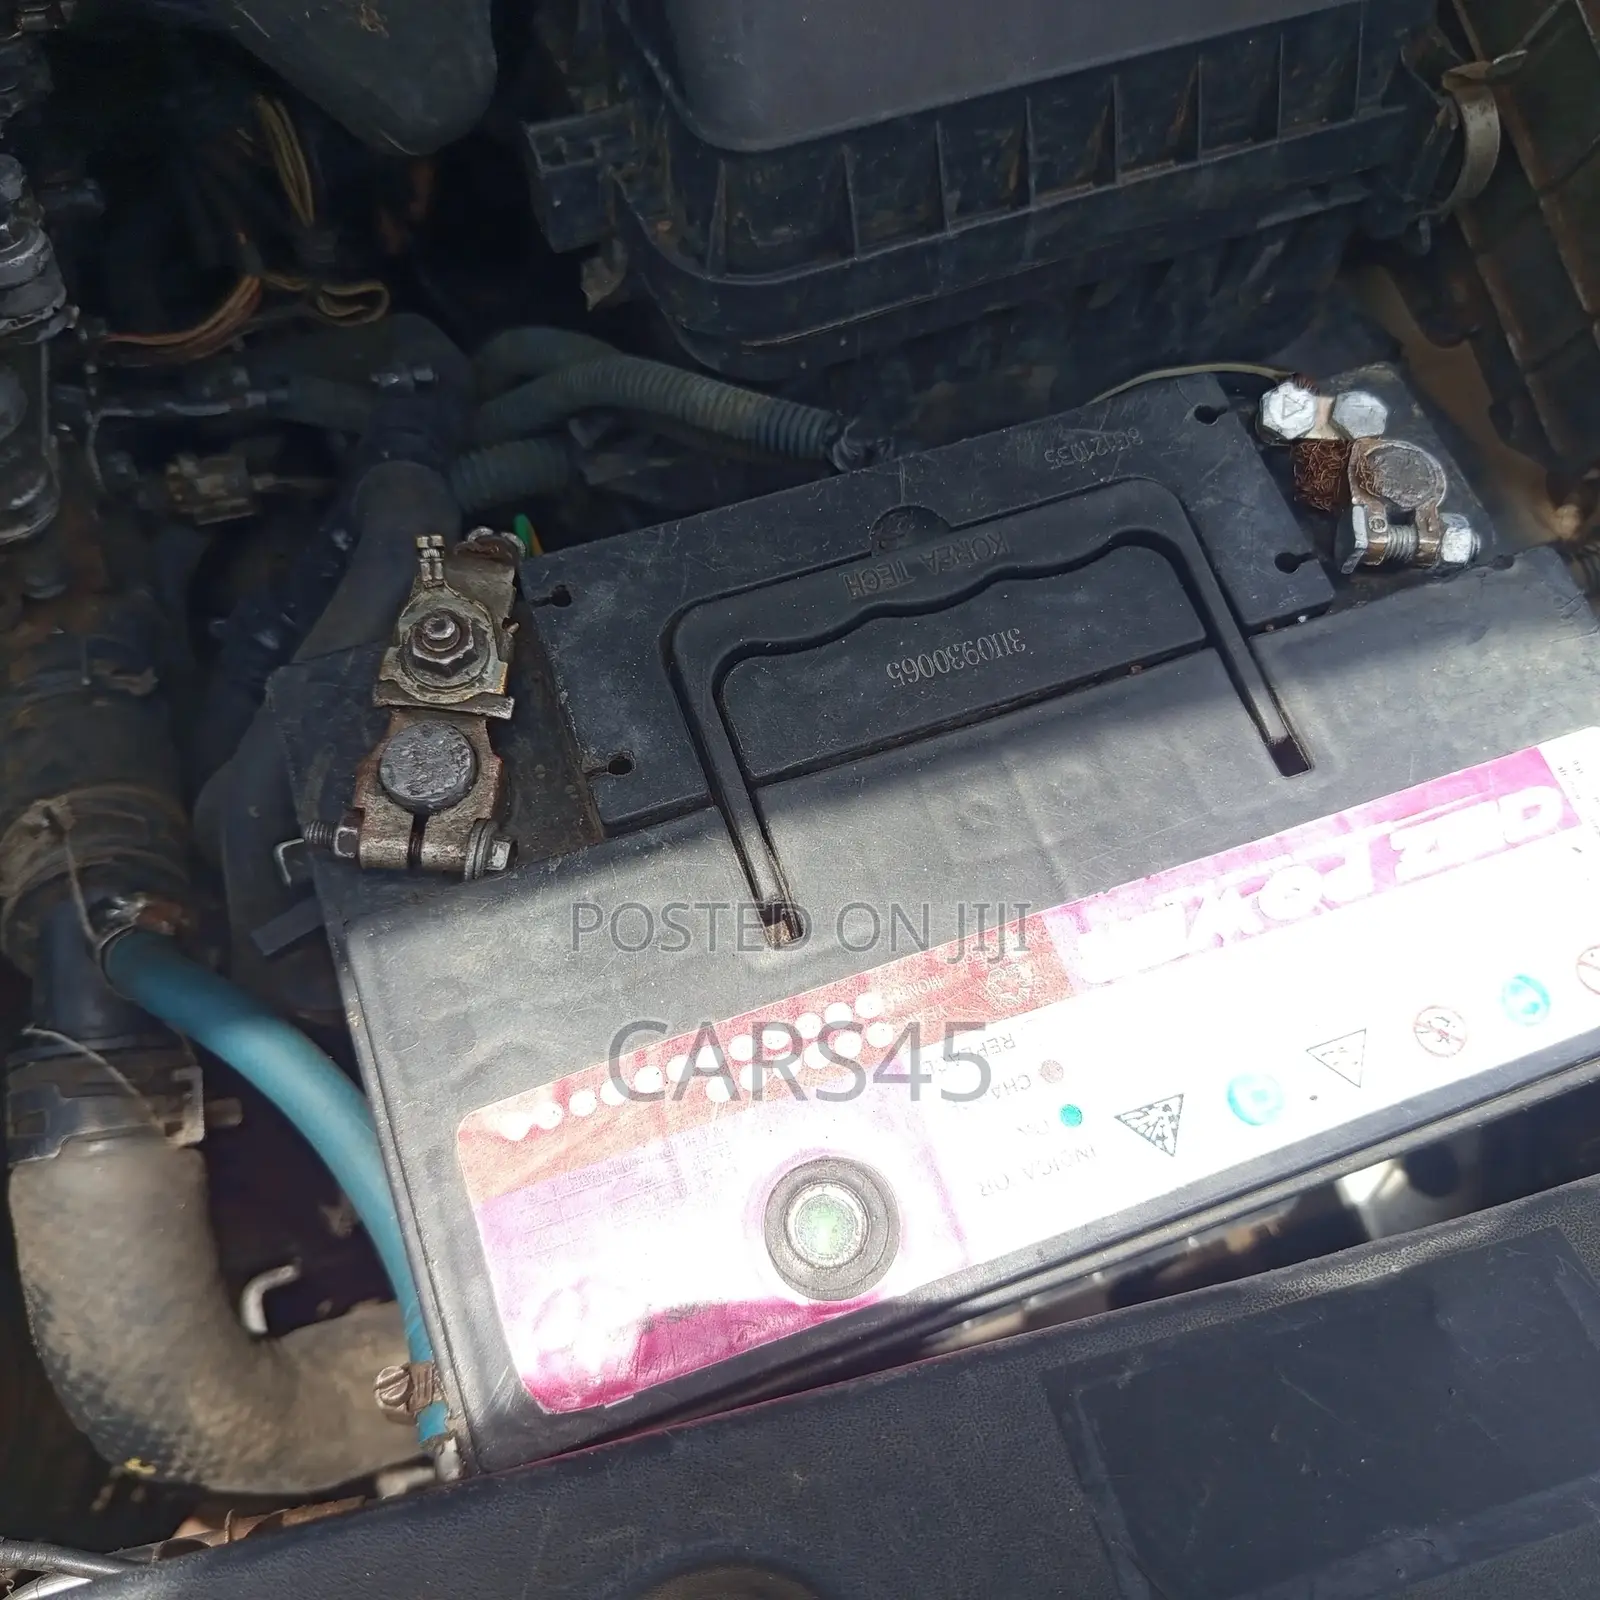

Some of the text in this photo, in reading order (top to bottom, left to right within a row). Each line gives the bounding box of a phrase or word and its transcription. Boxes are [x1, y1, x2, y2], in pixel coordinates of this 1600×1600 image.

[839, 529, 1011, 599] KOREA TECH
[978, 1144, 1096, 1197] INDICAOR
